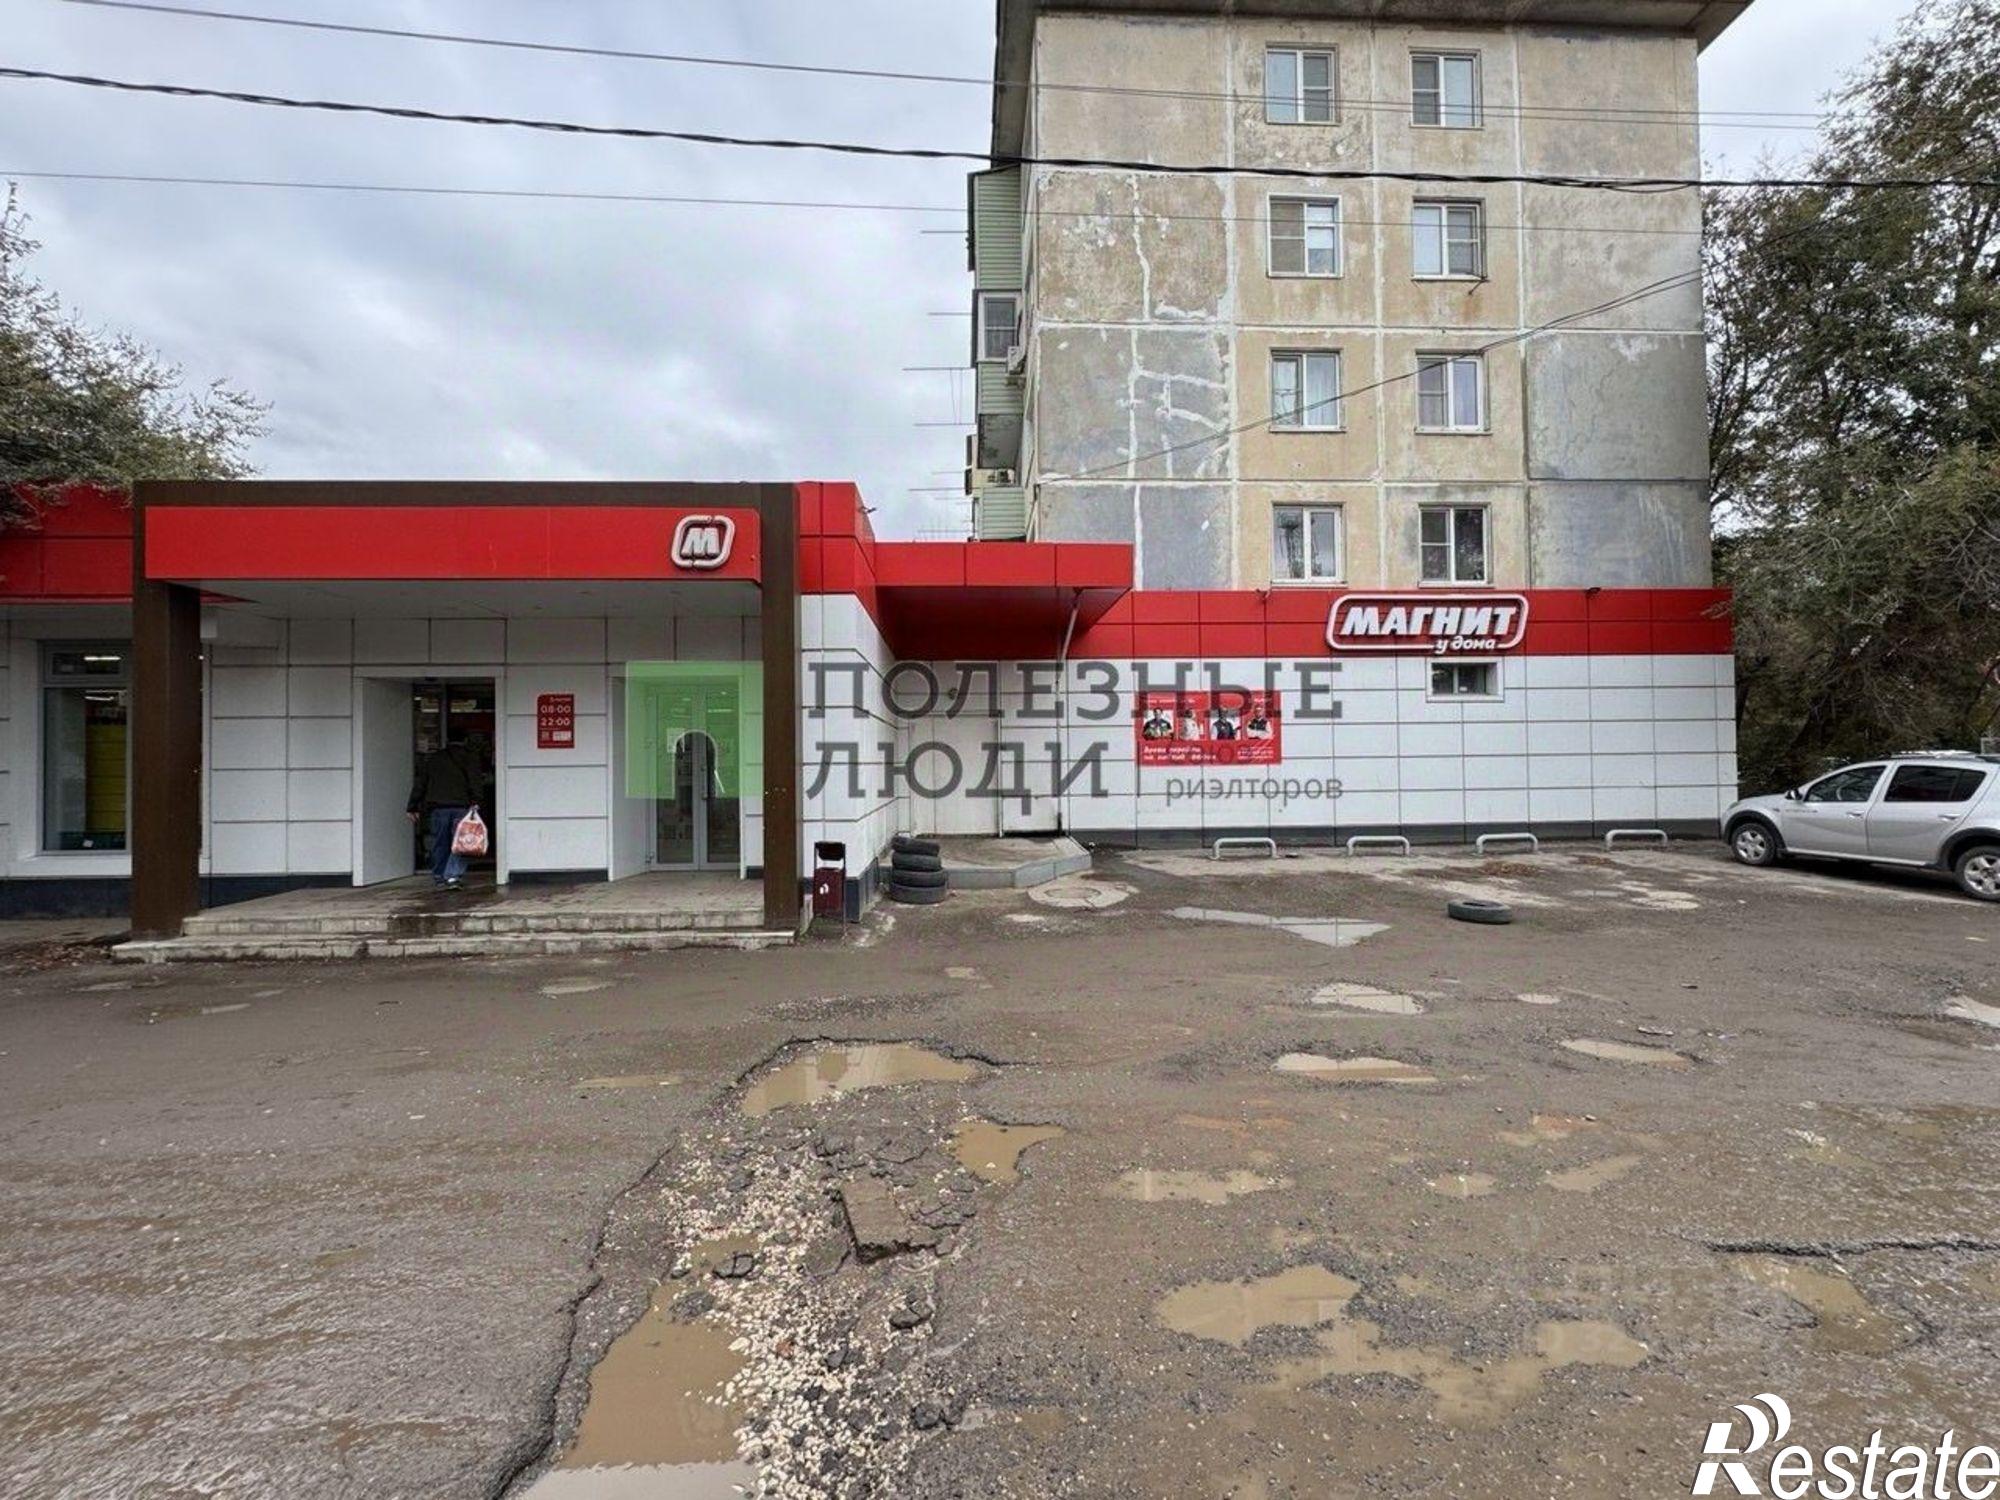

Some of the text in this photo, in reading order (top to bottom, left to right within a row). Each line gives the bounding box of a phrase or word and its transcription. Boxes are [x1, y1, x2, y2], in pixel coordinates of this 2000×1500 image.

[1340, 606, 1517, 635] МАГНИТ
[1433, 635, 1497, 654] у дома
